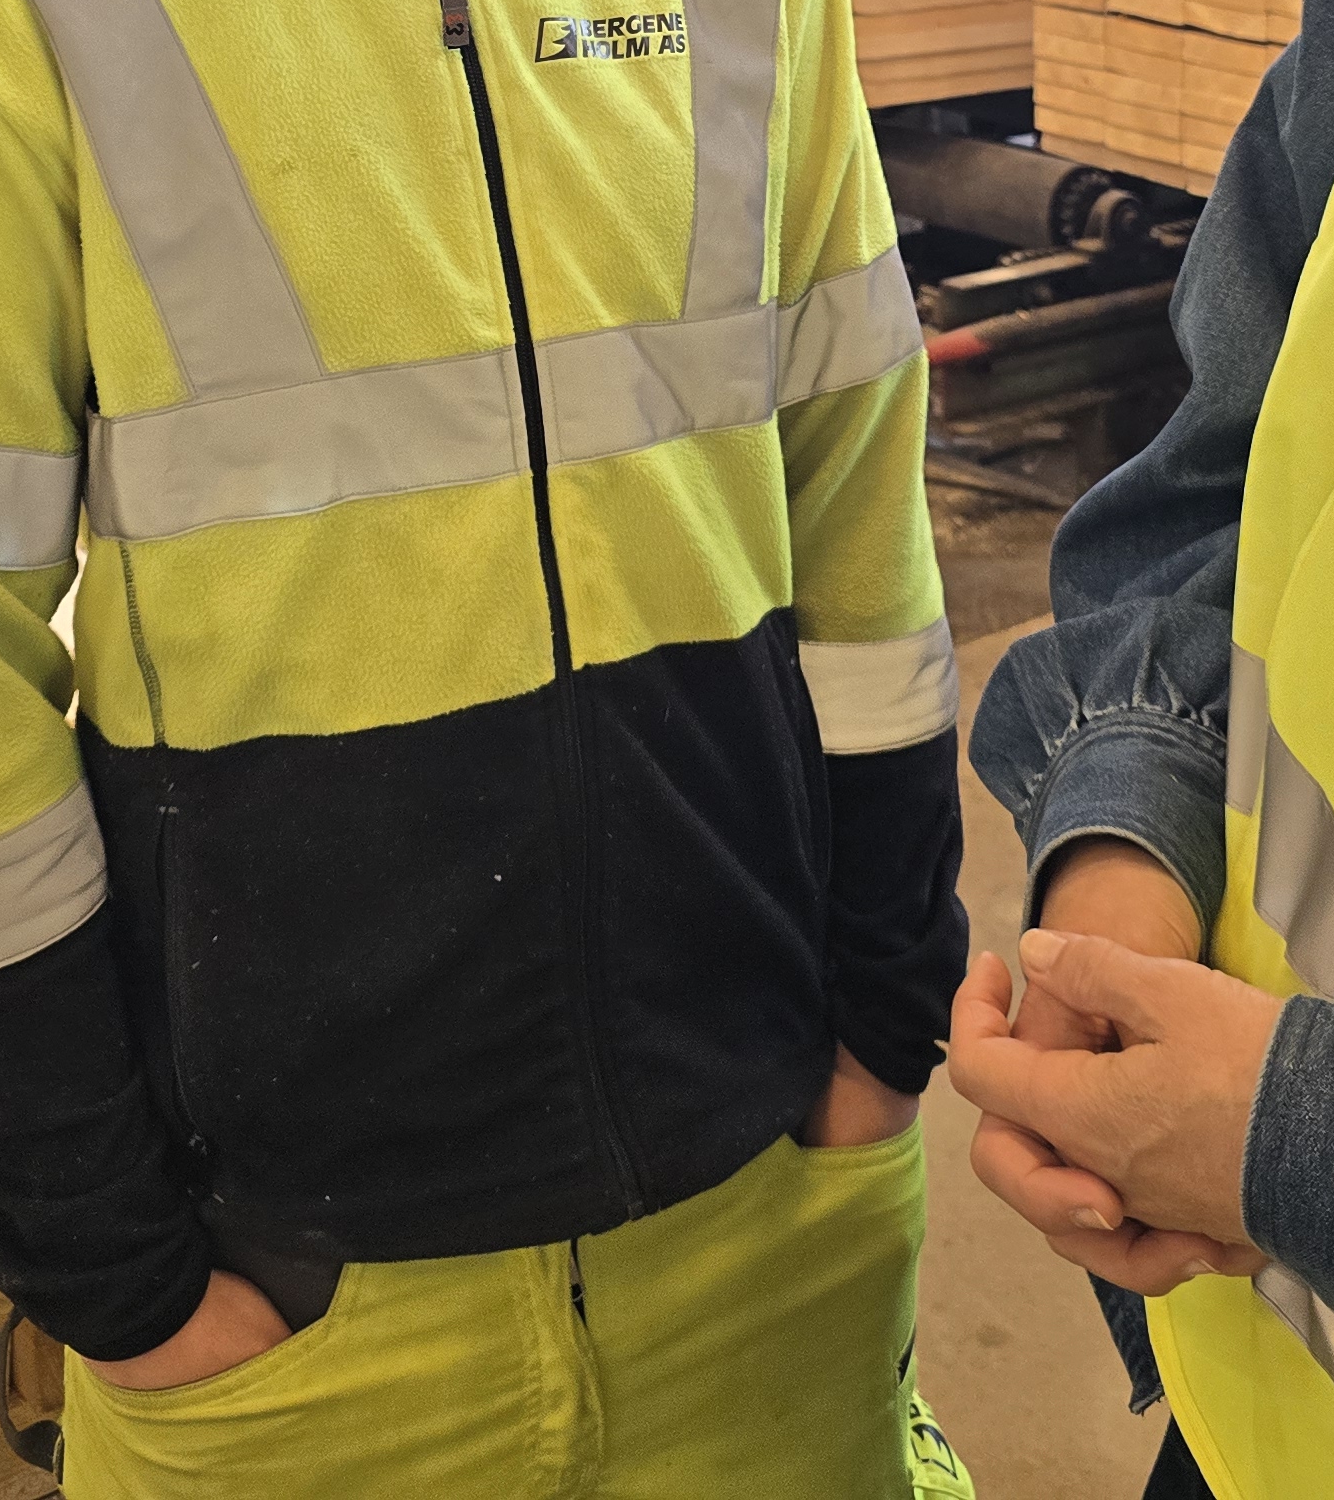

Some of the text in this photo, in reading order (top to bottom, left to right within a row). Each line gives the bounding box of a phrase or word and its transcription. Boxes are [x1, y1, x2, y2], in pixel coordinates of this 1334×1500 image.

[579, 12, 685, 39] BERGENE
[582, 34, 686, 60] HOLM AS
